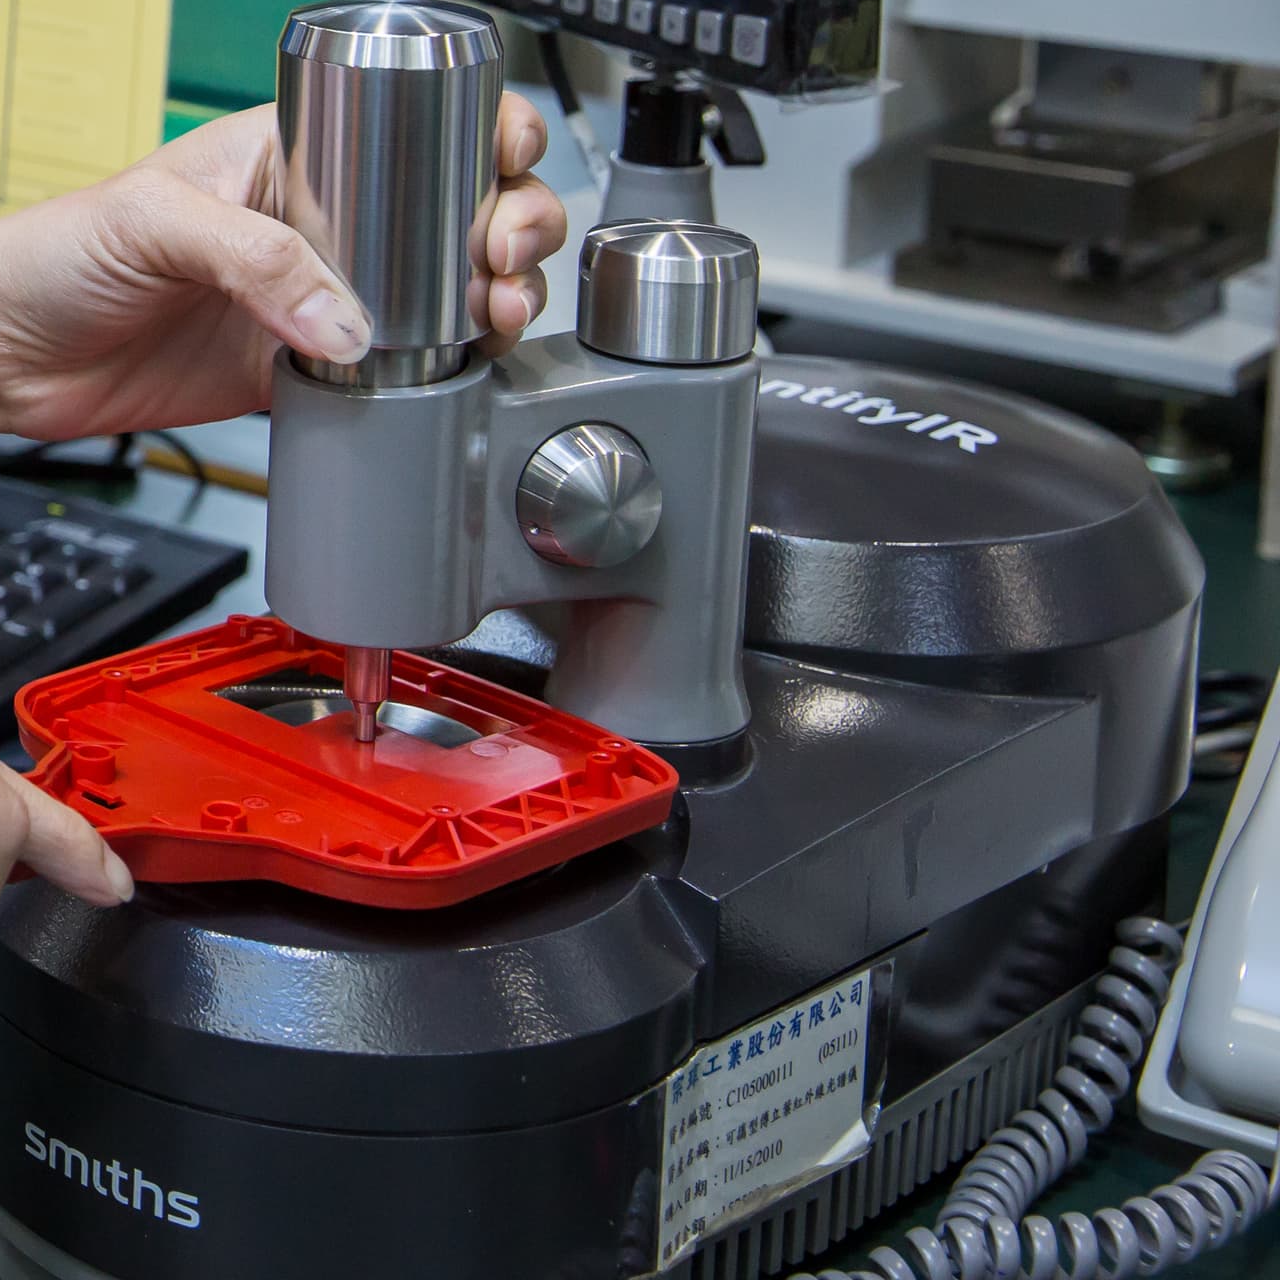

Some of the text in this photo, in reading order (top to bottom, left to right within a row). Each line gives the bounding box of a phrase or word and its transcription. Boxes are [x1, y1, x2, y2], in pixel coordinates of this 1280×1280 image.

[818, 1028, 858, 1064] (05111)
[24, 1121, 200, 1229] smiths
[724, 1139, 783, 1184] 11/15/2010
